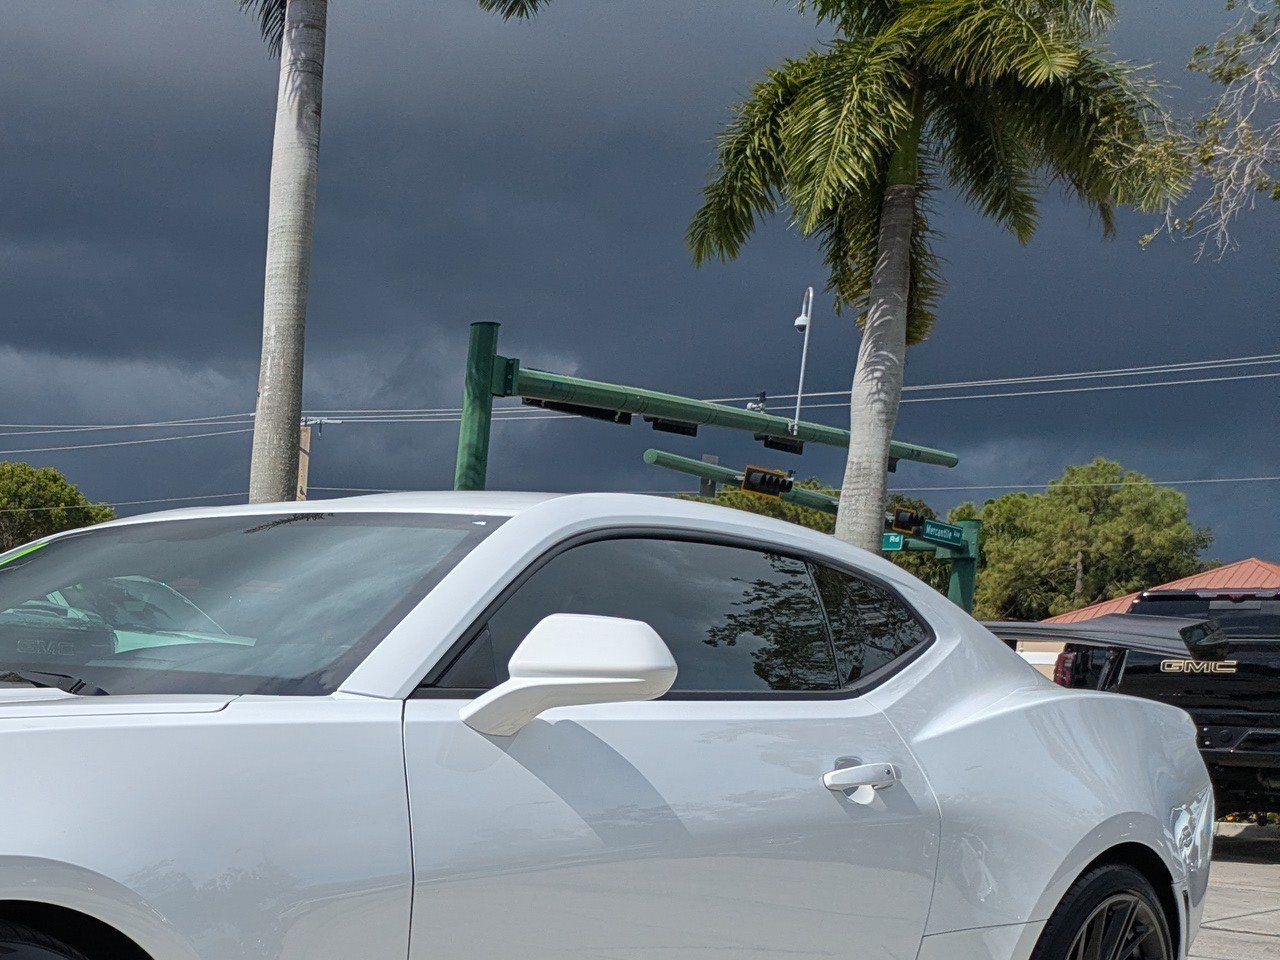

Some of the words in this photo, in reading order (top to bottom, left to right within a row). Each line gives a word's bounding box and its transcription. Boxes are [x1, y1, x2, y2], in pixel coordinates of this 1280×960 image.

[889, 535, 900, 543] Rd
[12, 639, 75, 657] GMC
[1160, 659, 1237, 674] GMC
